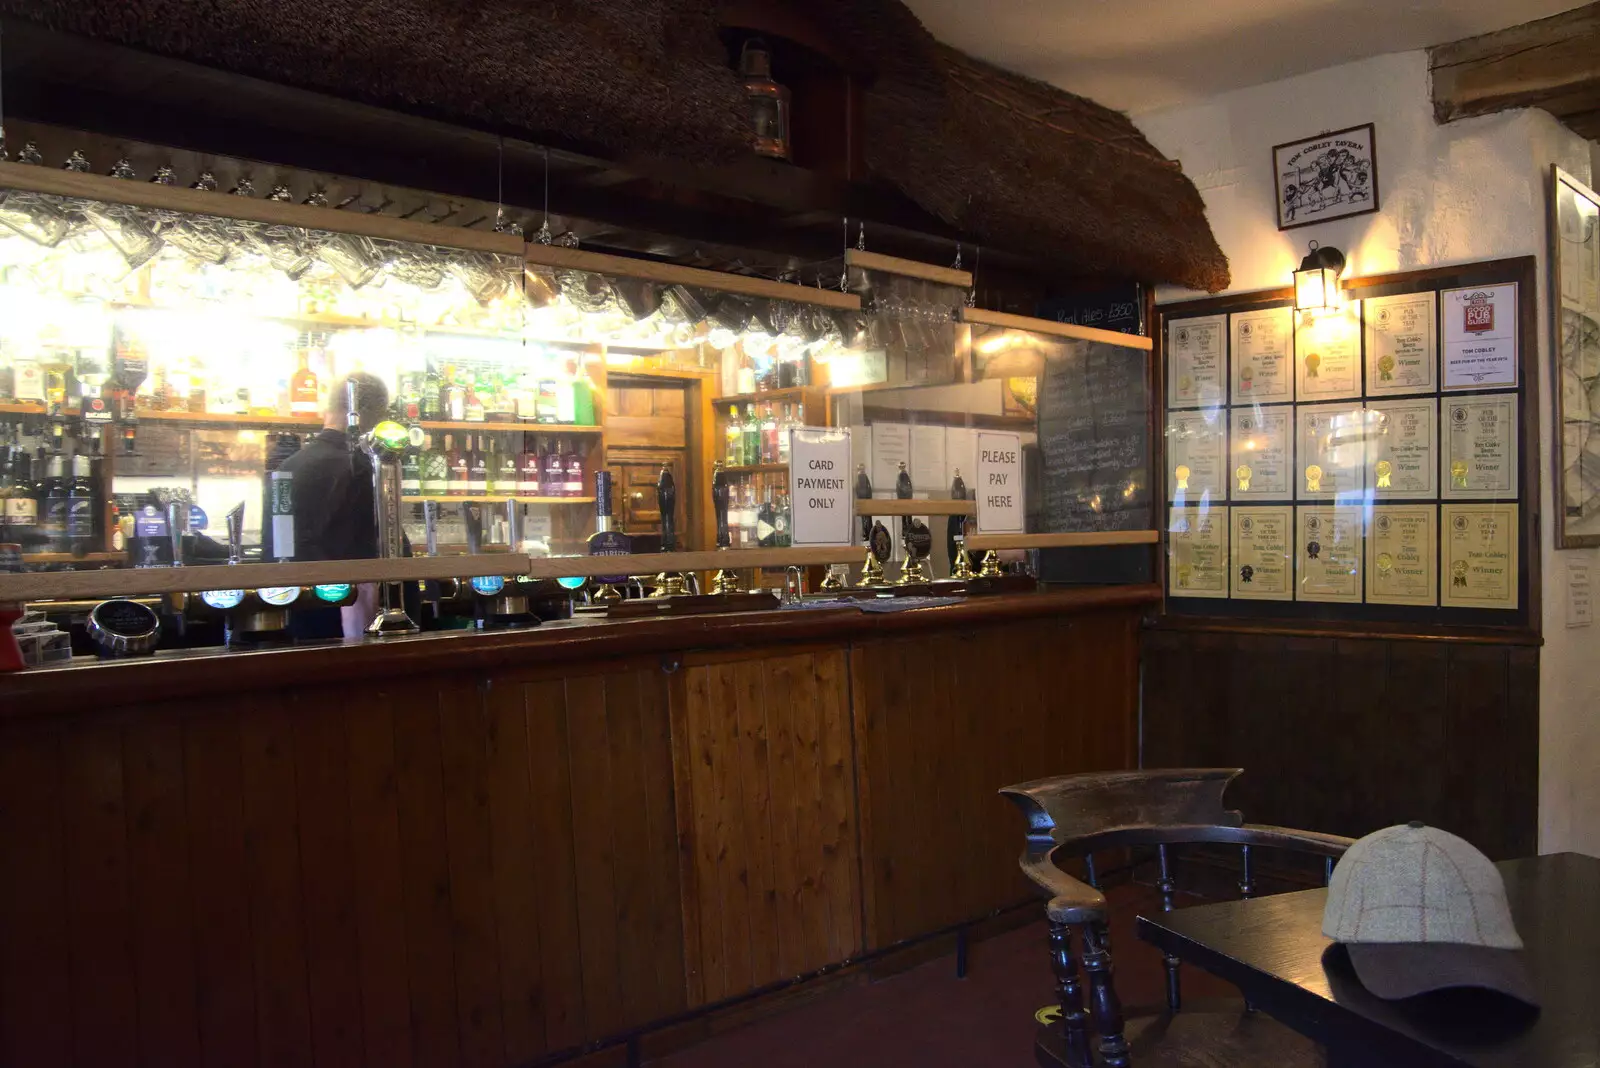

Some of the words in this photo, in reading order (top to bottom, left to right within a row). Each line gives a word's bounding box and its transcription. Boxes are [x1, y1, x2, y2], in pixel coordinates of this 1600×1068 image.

[1287, 153, 1301, 166] TOM
[1303, 142, 1332, 154] COBLEY
[1334, 141, 1364, 151] TAVERN
[1467, 305, 1491, 313] GOOD
[1467, 311, 1491, 320] PUB
[981, 450, 1016, 464] PLEASE
[808, 460, 834, 470] CARD
[797, 478, 845, 489] PAYMENT
[989, 473, 1008, 485] PAY
[808, 498, 835, 509] ONLY
[987, 495, 1013, 508] HERE
[1394, 567, 1423, 575] Winner
[1473, 566, 1504, 574] Winner
